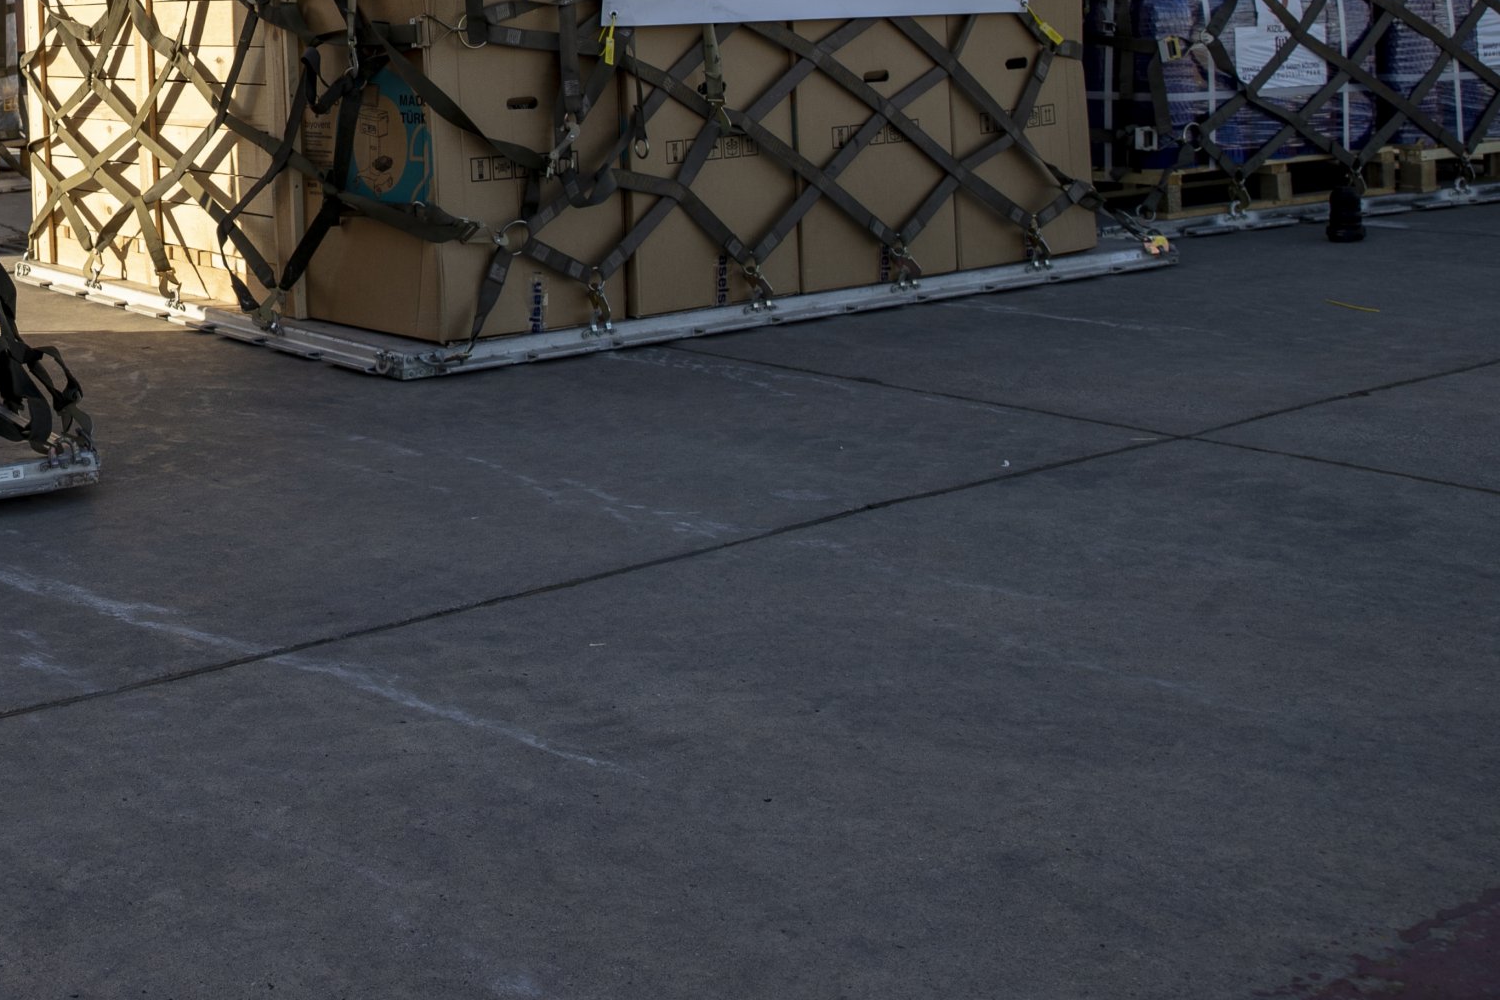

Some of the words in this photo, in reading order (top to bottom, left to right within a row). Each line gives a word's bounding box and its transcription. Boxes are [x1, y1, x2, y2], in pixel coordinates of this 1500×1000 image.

[400, 94, 425, 107] MAD
[401, 110, 426, 125] TÜRK
[718, 254, 730, 304] asels
[529, 282, 542, 333] elsan
